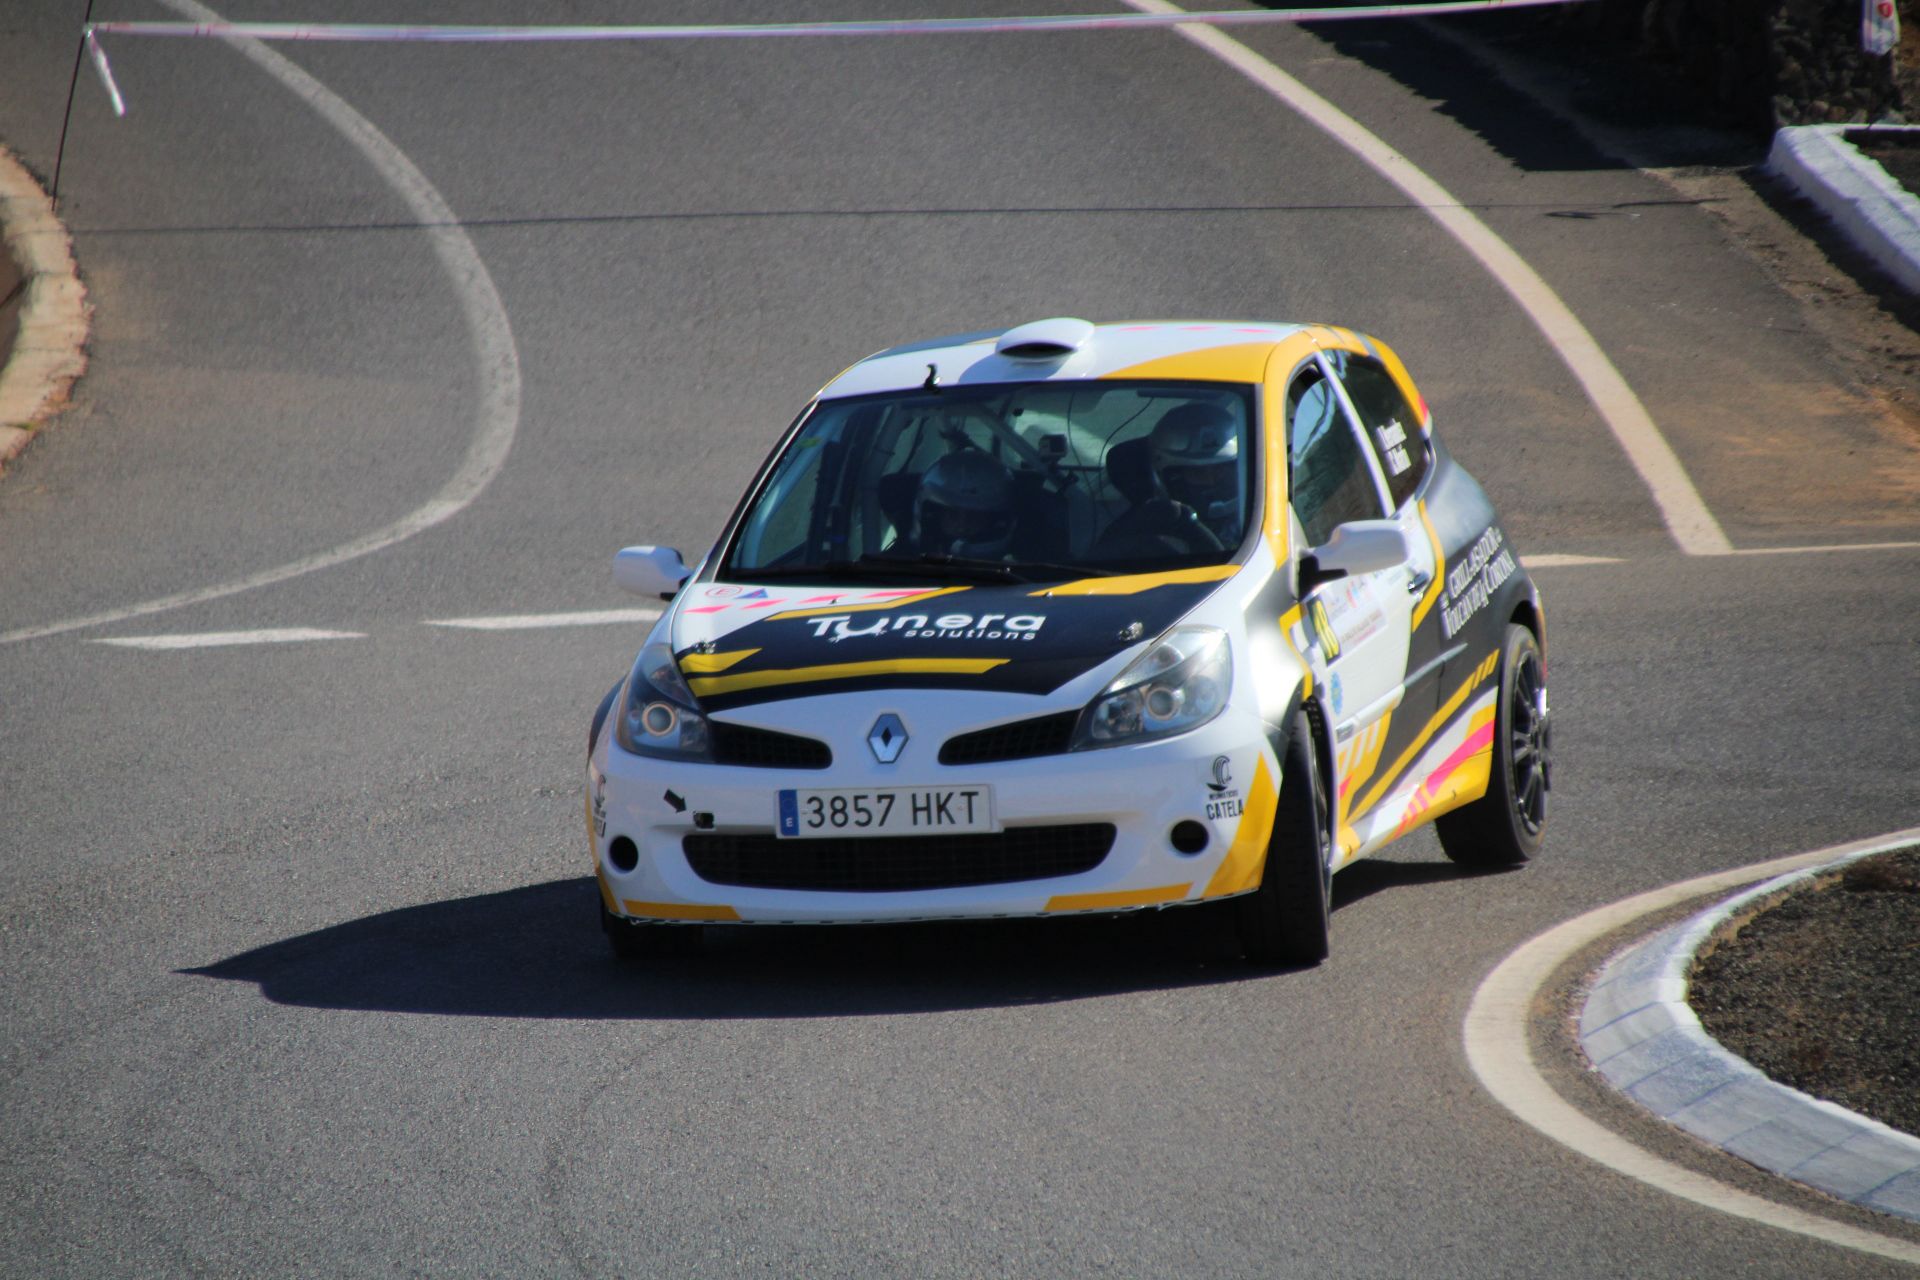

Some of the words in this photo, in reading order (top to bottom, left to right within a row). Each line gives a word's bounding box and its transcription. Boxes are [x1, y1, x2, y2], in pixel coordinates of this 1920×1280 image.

[807, 614, 1046, 641] Tunera
[904, 629, 1036, 640] solutions
[807, 795, 895, 828] 3857
[911, 792, 979, 825] HKT
[1206, 800, 1244, 820] CATELA
